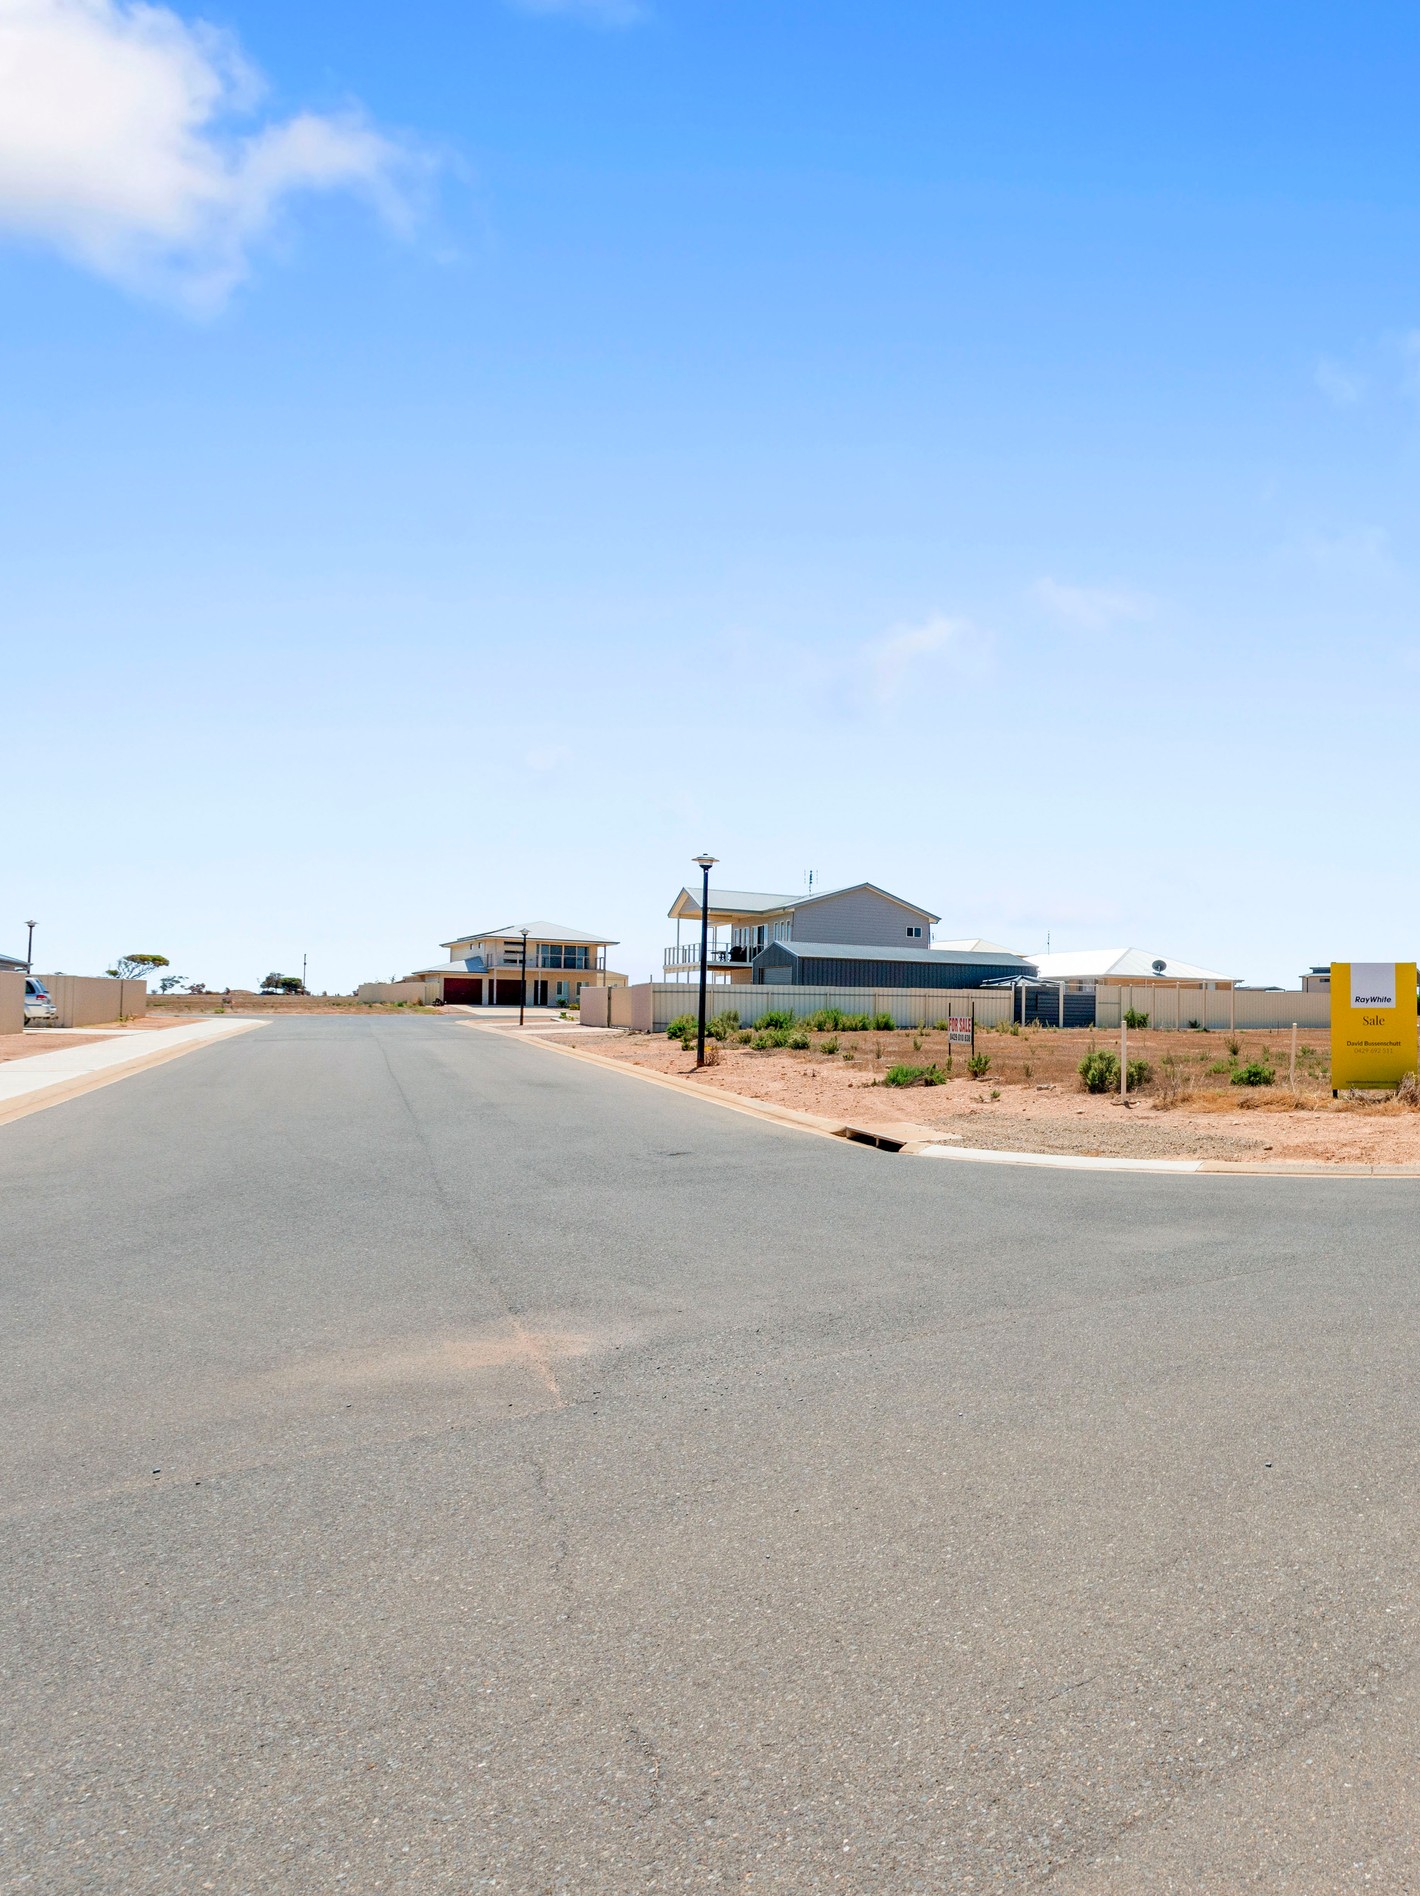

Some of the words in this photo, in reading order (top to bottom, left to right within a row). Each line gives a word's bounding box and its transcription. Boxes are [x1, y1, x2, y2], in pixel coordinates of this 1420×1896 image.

[1355, 996, 1392, 1004] RayWhite
[949, 1018, 958, 1032] FOR
[960, 1018, 970, 1032] SALE
[1362, 1015, 1386, 1026] Sale
